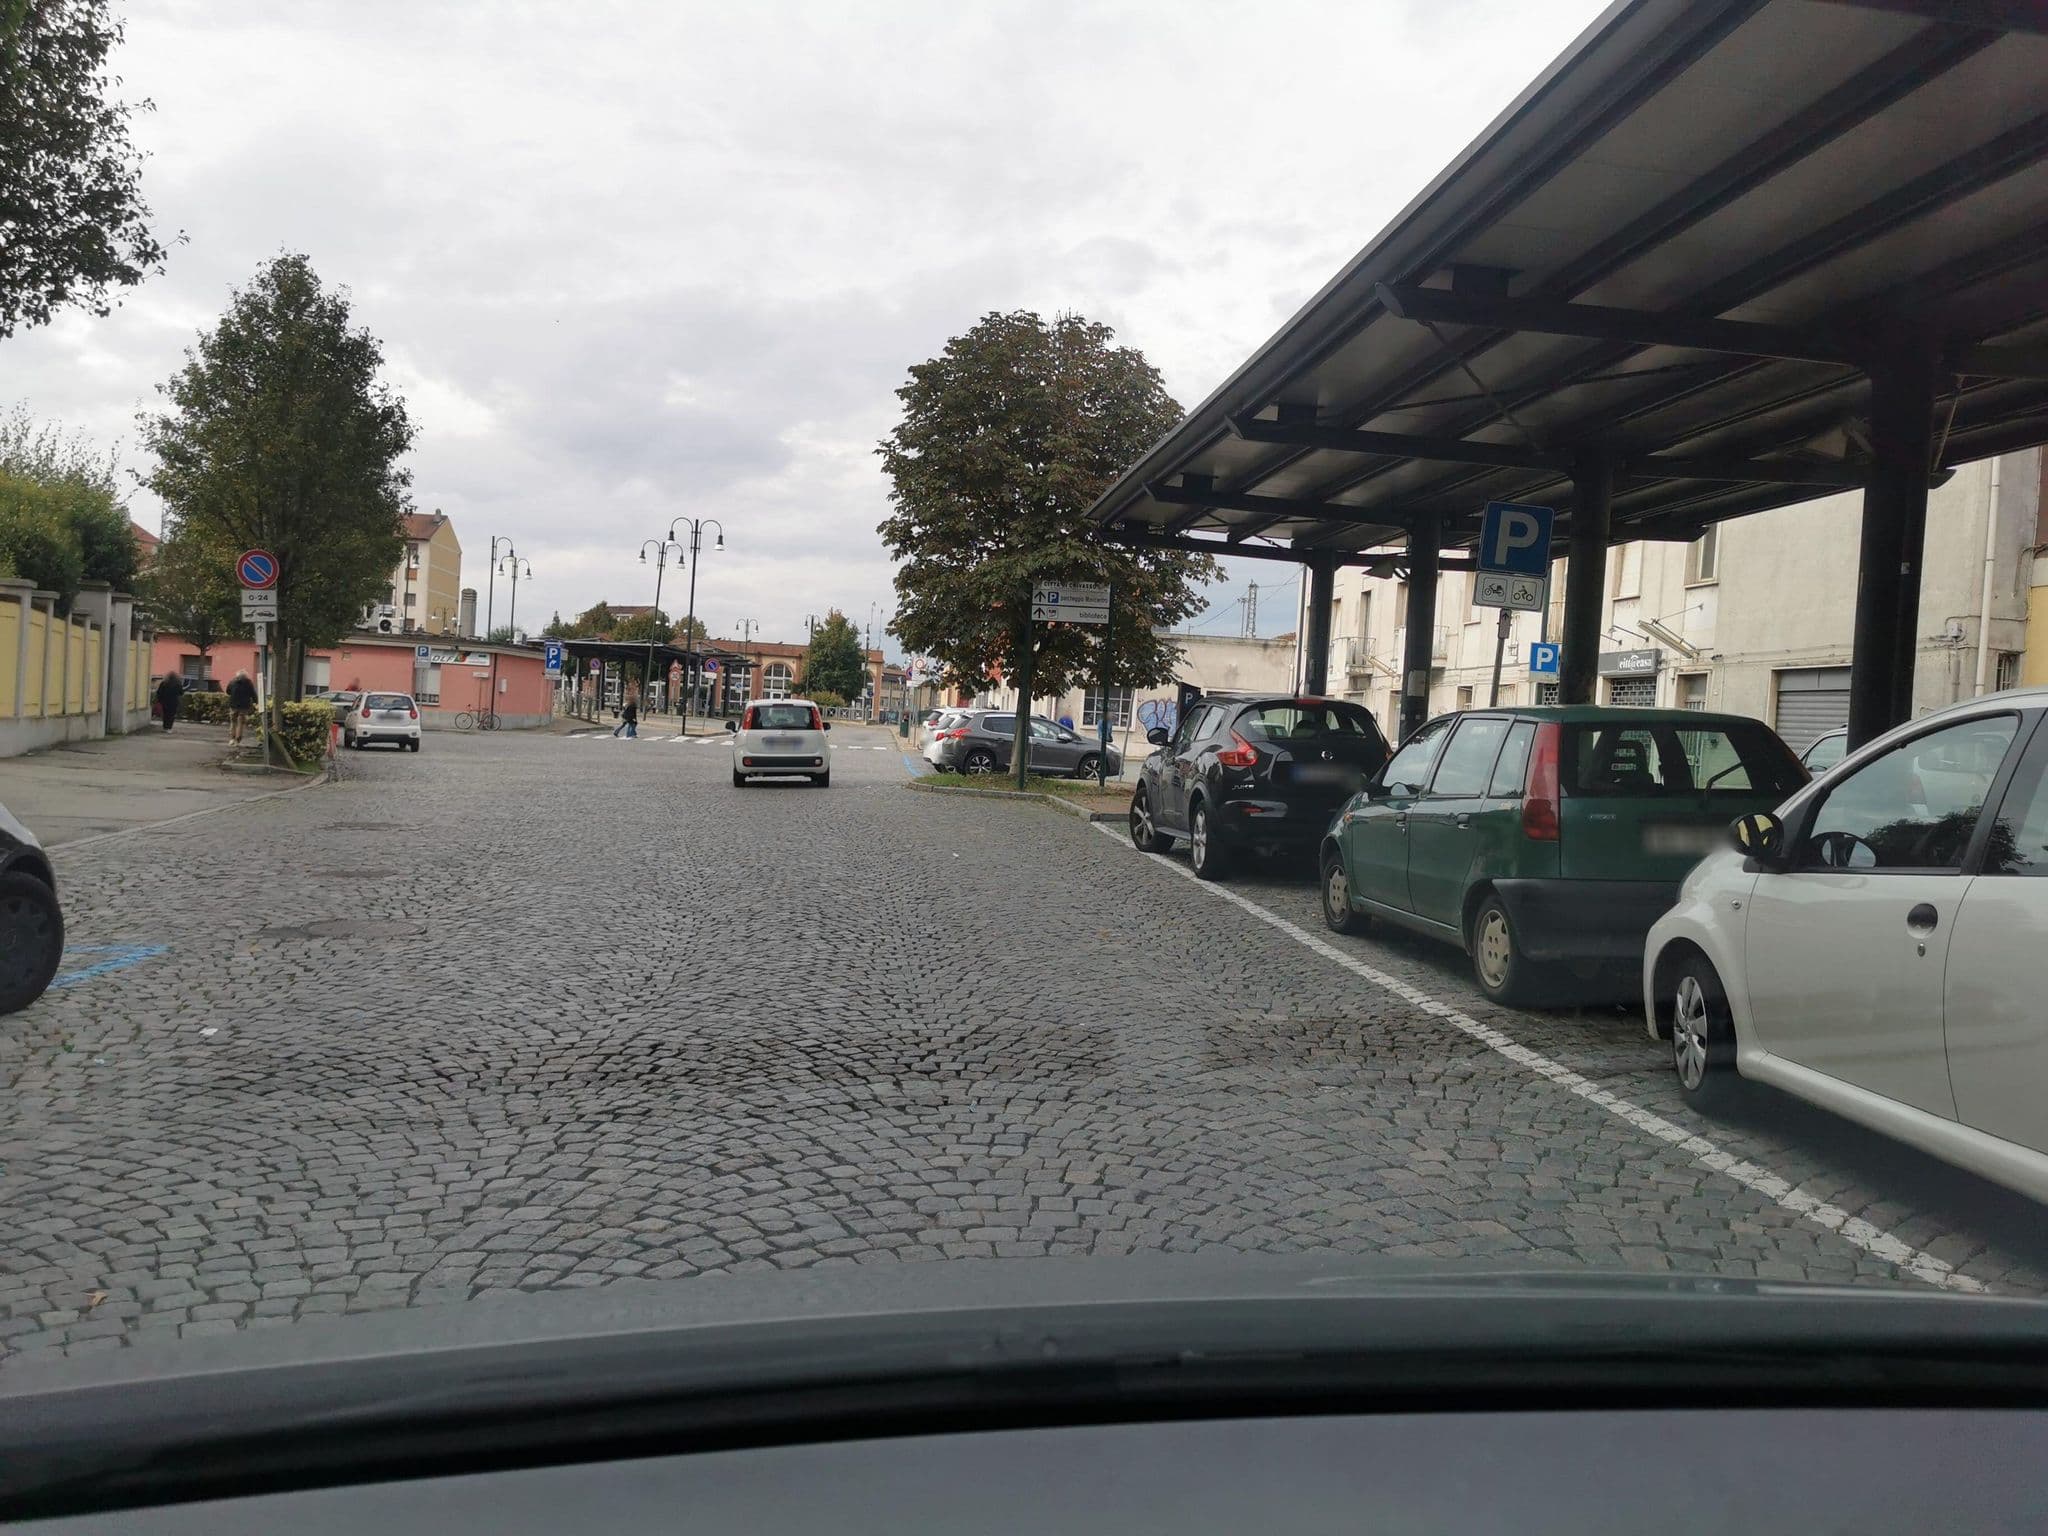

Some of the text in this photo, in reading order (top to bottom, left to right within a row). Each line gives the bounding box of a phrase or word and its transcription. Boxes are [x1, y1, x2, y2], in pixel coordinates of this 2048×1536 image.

[1495, 510, 1539, 565] P
[1050, 593, 1057, 602] P
[1079, 611, 1107, 619] biblioteca
[419, 647, 428, 656] P
[549, 647, 558, 659] P
[1536, 647, 1554, 670] P
[1185, 692, 1193, 705] P
